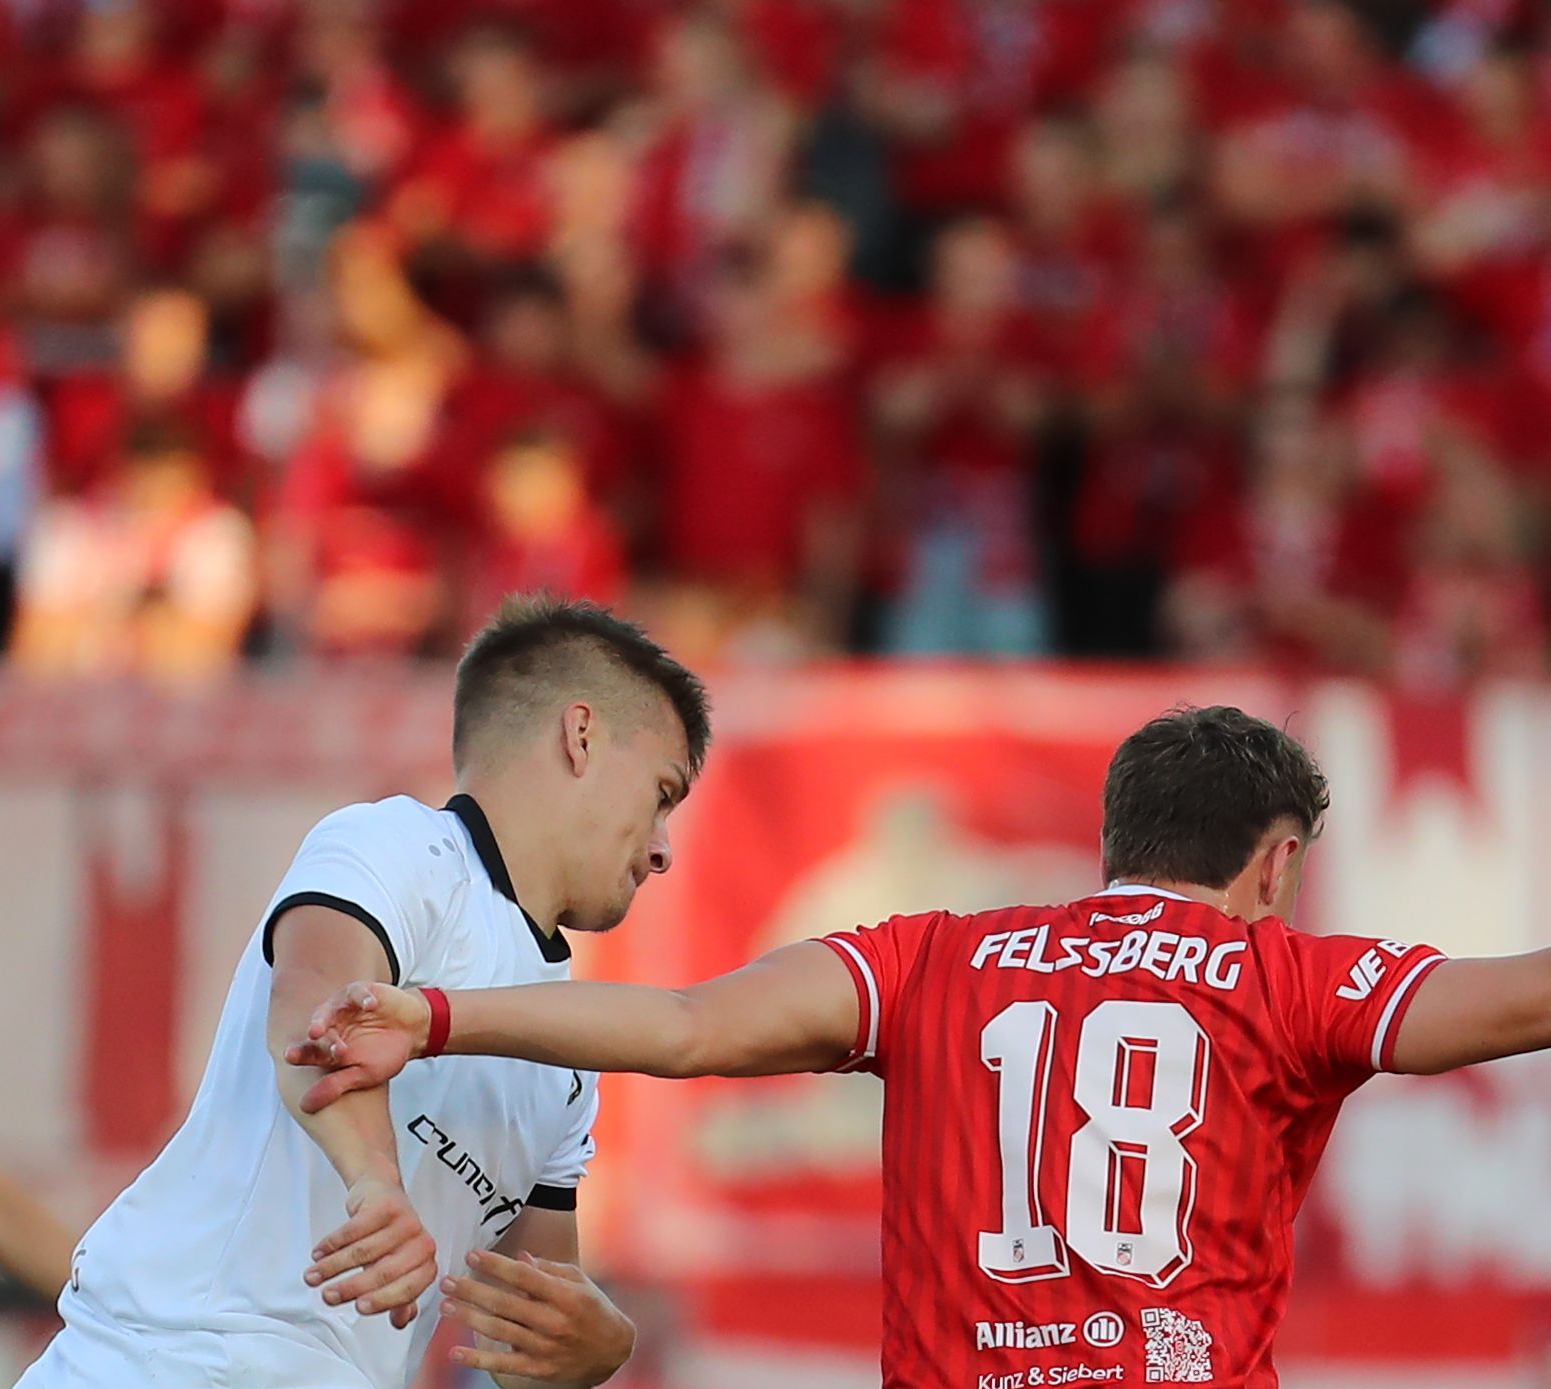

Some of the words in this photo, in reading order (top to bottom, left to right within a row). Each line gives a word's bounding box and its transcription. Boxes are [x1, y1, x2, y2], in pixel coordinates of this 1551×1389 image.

[969, 923, 1248, 991] FELSSBERG
[979, 1000, 1210, 1289] 18
[975, 1321, 1077, 1351] Allianz
[1027, 1366, 1045, 1387] &
[1047, 1363, 1124, 1387] Siebert
